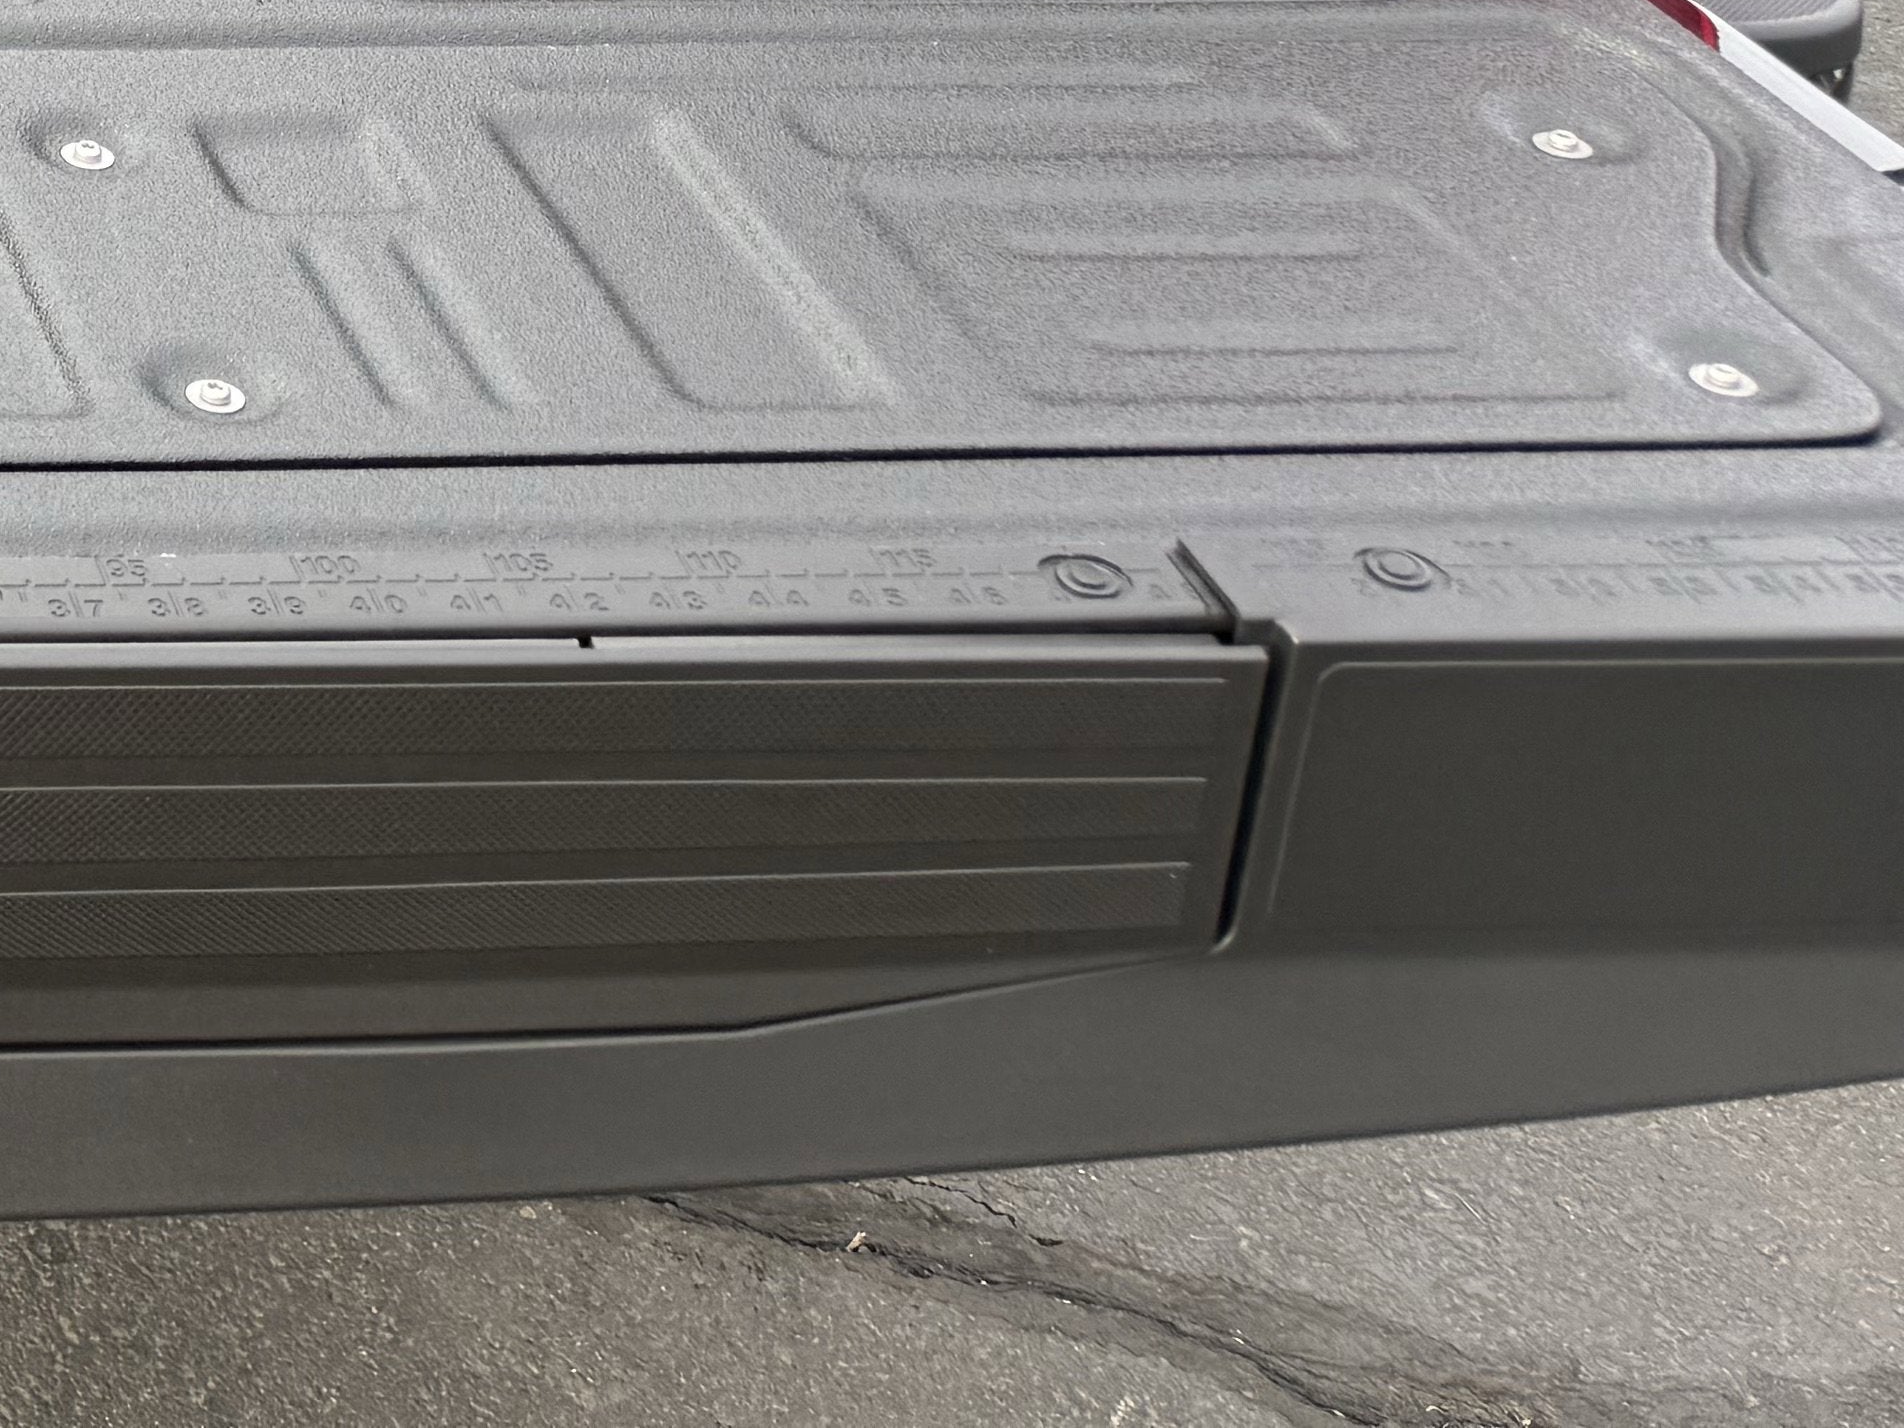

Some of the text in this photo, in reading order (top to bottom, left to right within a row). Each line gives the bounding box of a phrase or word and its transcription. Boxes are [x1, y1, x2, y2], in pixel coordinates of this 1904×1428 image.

[105, 557, 150, 579] 95
[299, 554, 363, 576] 100
[493, 552, 555, 574] 105
[47, 597, 107, 620] 37
